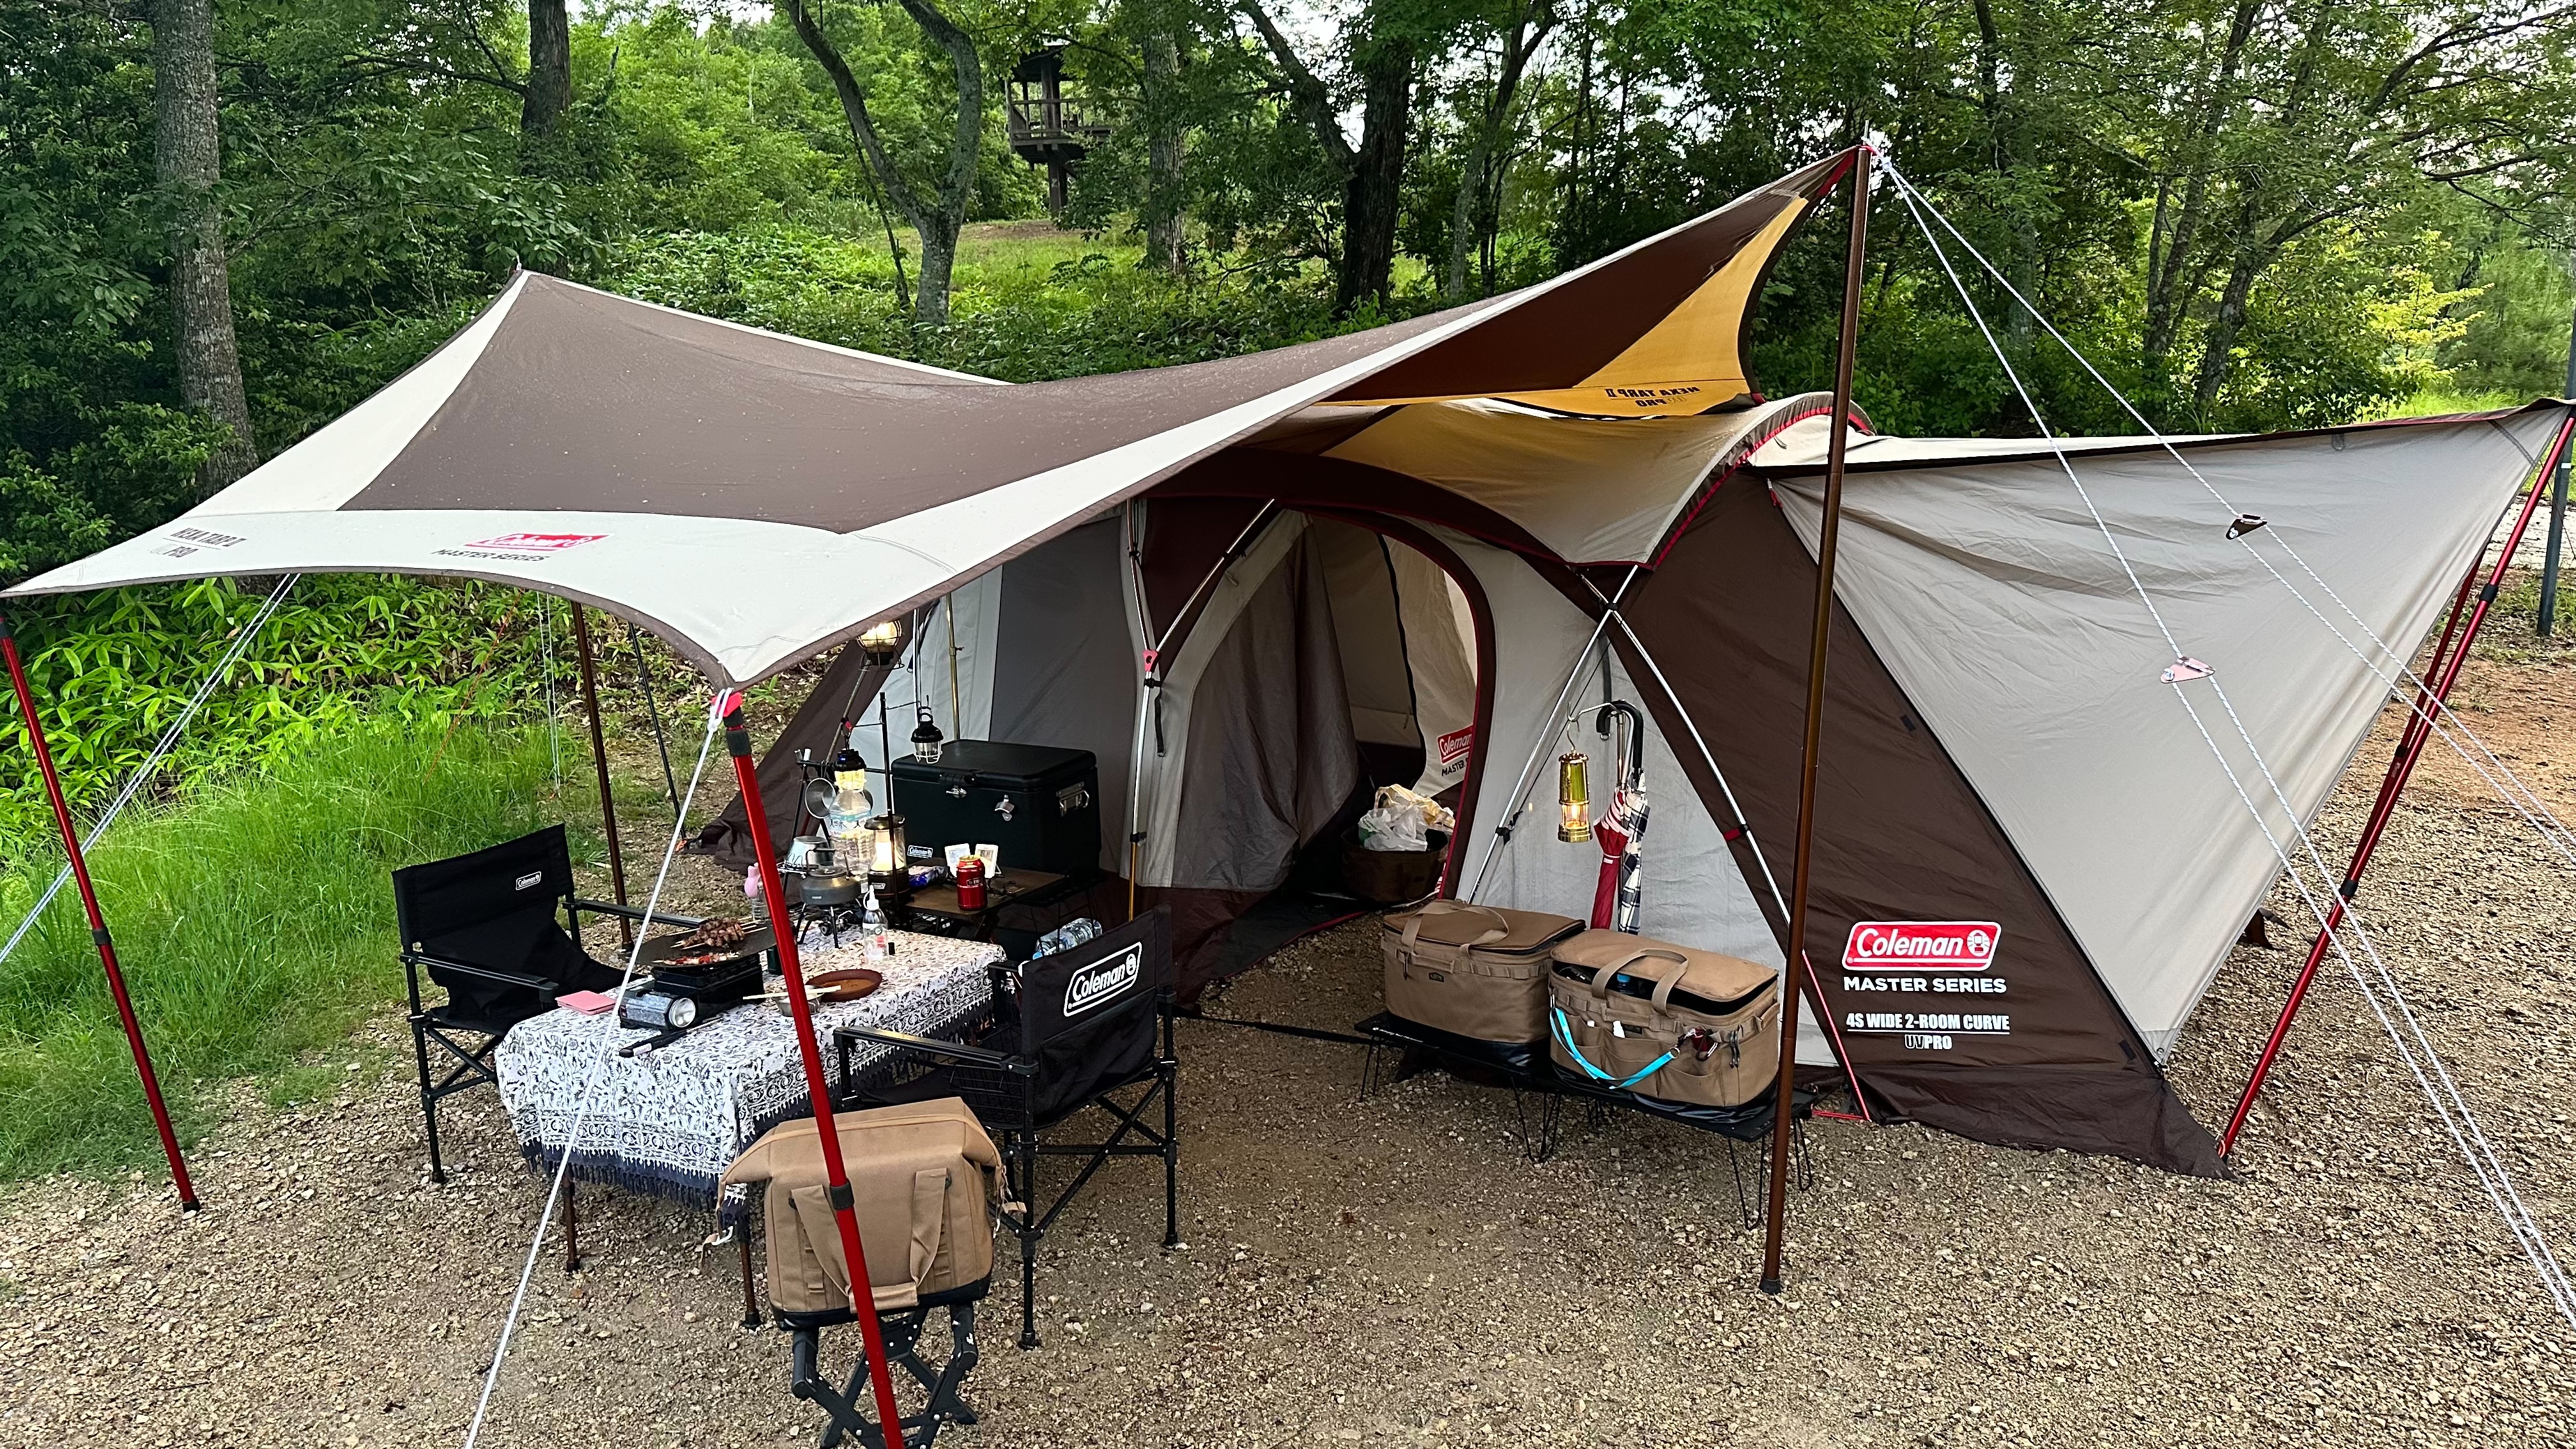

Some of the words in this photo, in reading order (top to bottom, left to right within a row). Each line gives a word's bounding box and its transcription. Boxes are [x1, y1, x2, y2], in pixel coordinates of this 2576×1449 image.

[431, 549, 496, 558] MASTER
[491, 553, 551, 562] SERIES
[1441, 760, 1466, 777] MASTER
[1856, 928, 1964, 957] Coleman
[1072, 963, 1126, 1002] Coleman
[1843, 976, 1928, 992] MASTER
[1932, 977, 2007, 993] SERIES
[1846, 1013, 1864, 1028] 4S
[1866, 1013, 1903, 1029] WIDE
[1905, 1013, 1961, 1030] 2-ROOM
[1963, 1015, 2011, 1031] CURVE
[1905, 1034, 1952, 1050] UVPRO
